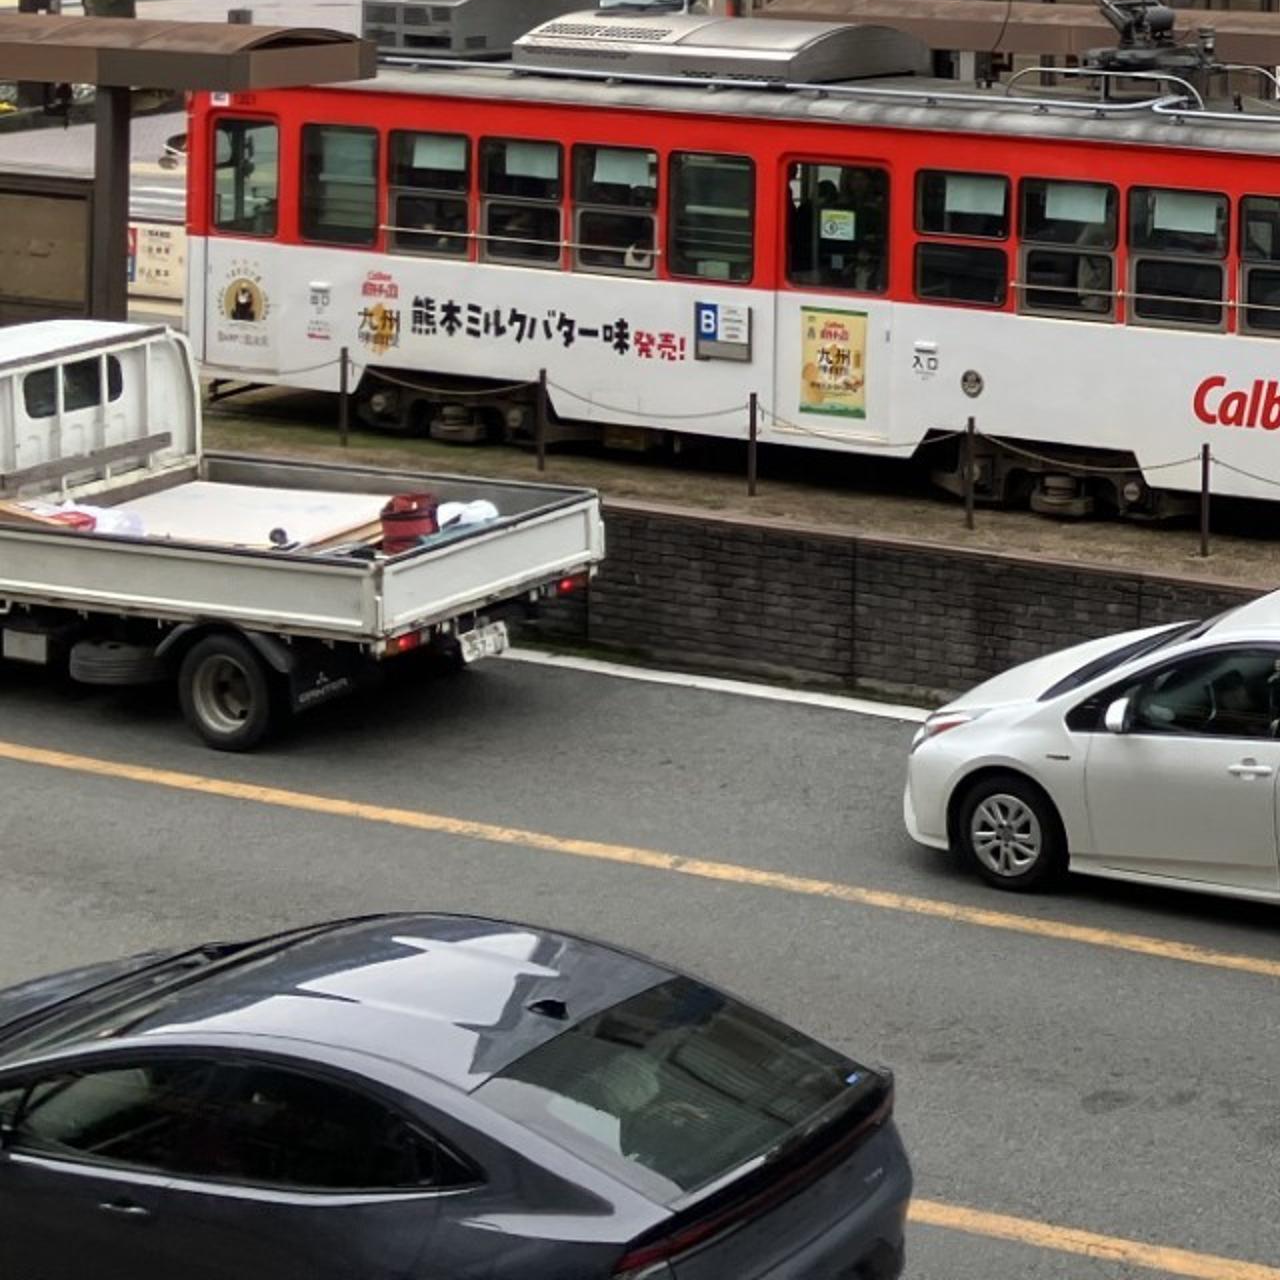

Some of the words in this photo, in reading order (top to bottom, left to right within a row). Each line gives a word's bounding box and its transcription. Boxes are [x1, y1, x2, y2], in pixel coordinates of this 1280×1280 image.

[357, 307, 401, 336] 九州
[411, 295, 630, 356] 熊本ミルクバター味
[701, 309, 716, 333] B
[912, 355, 938, 370] 入口
